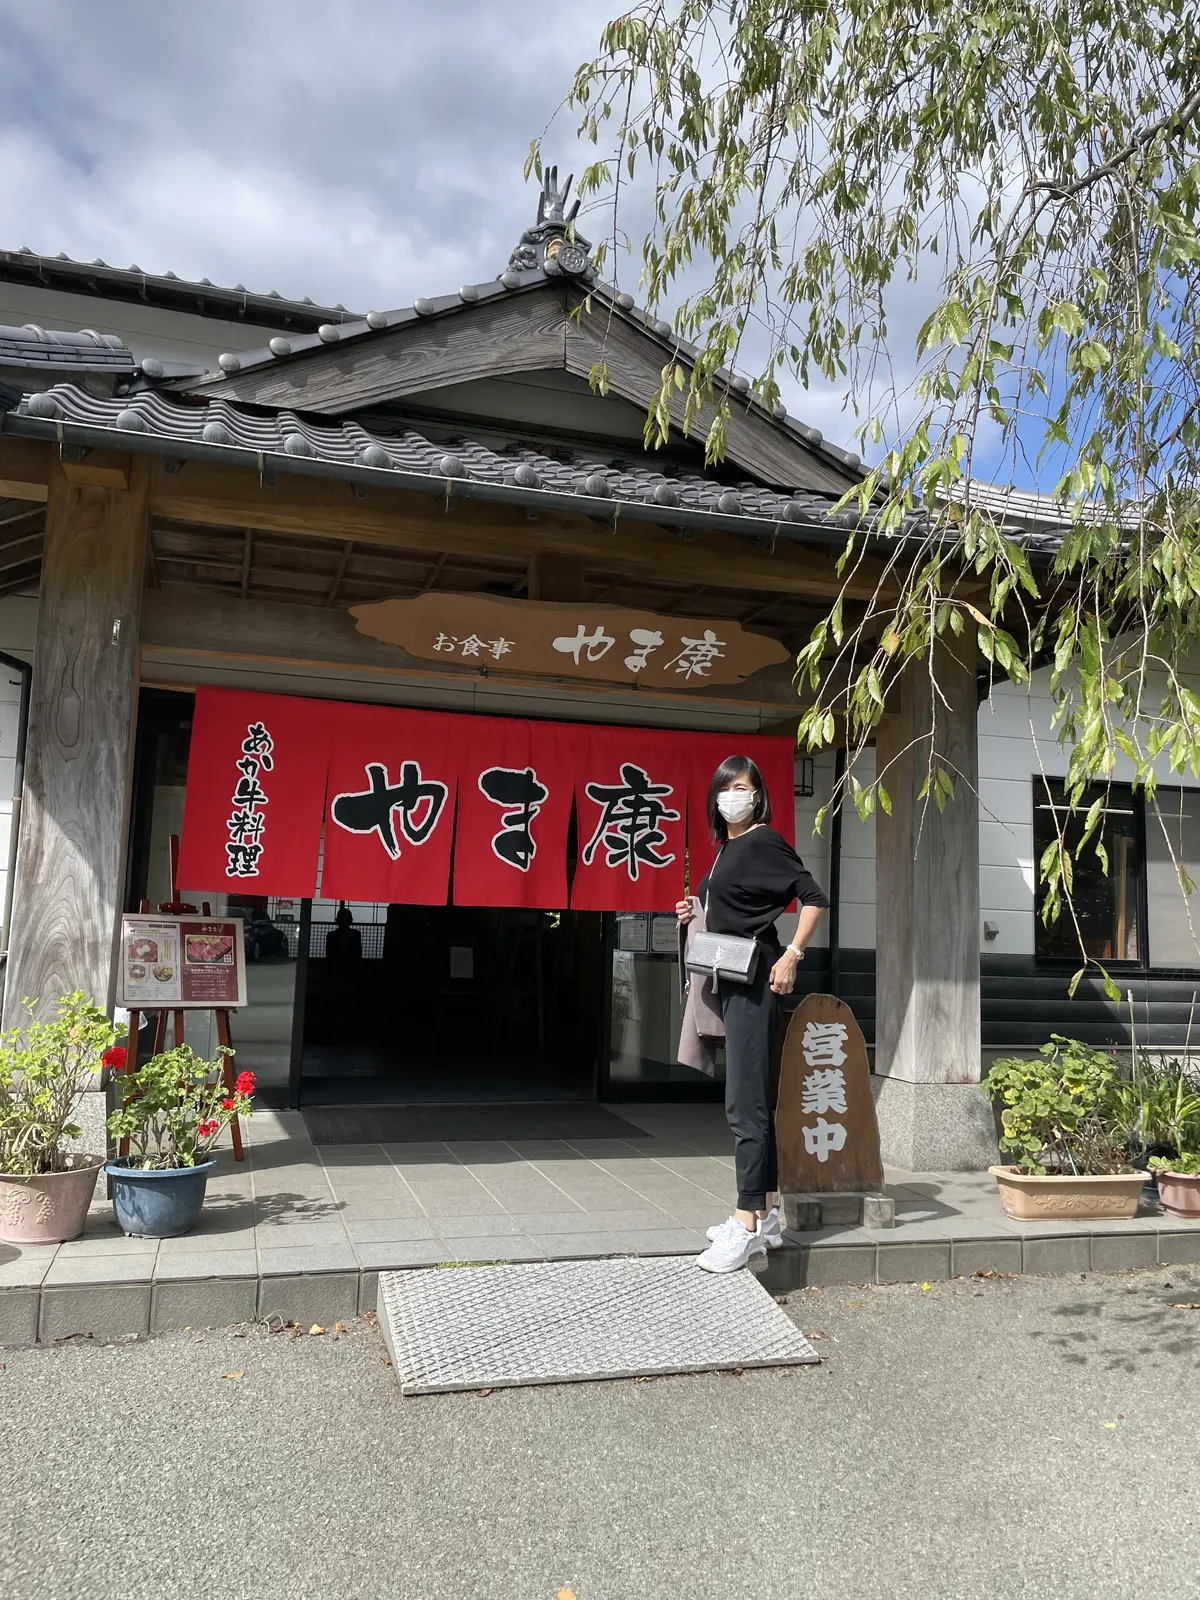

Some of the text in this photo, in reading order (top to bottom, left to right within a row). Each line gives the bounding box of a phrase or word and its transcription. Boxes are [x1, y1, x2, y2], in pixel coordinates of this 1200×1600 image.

[432, 624, 727, 680] お食事 やま康
[224, 721, 275, 878] あか牛料理
[330, 760, 681, 882] やま康
[801, 1021, 849, 1163] 営業中
